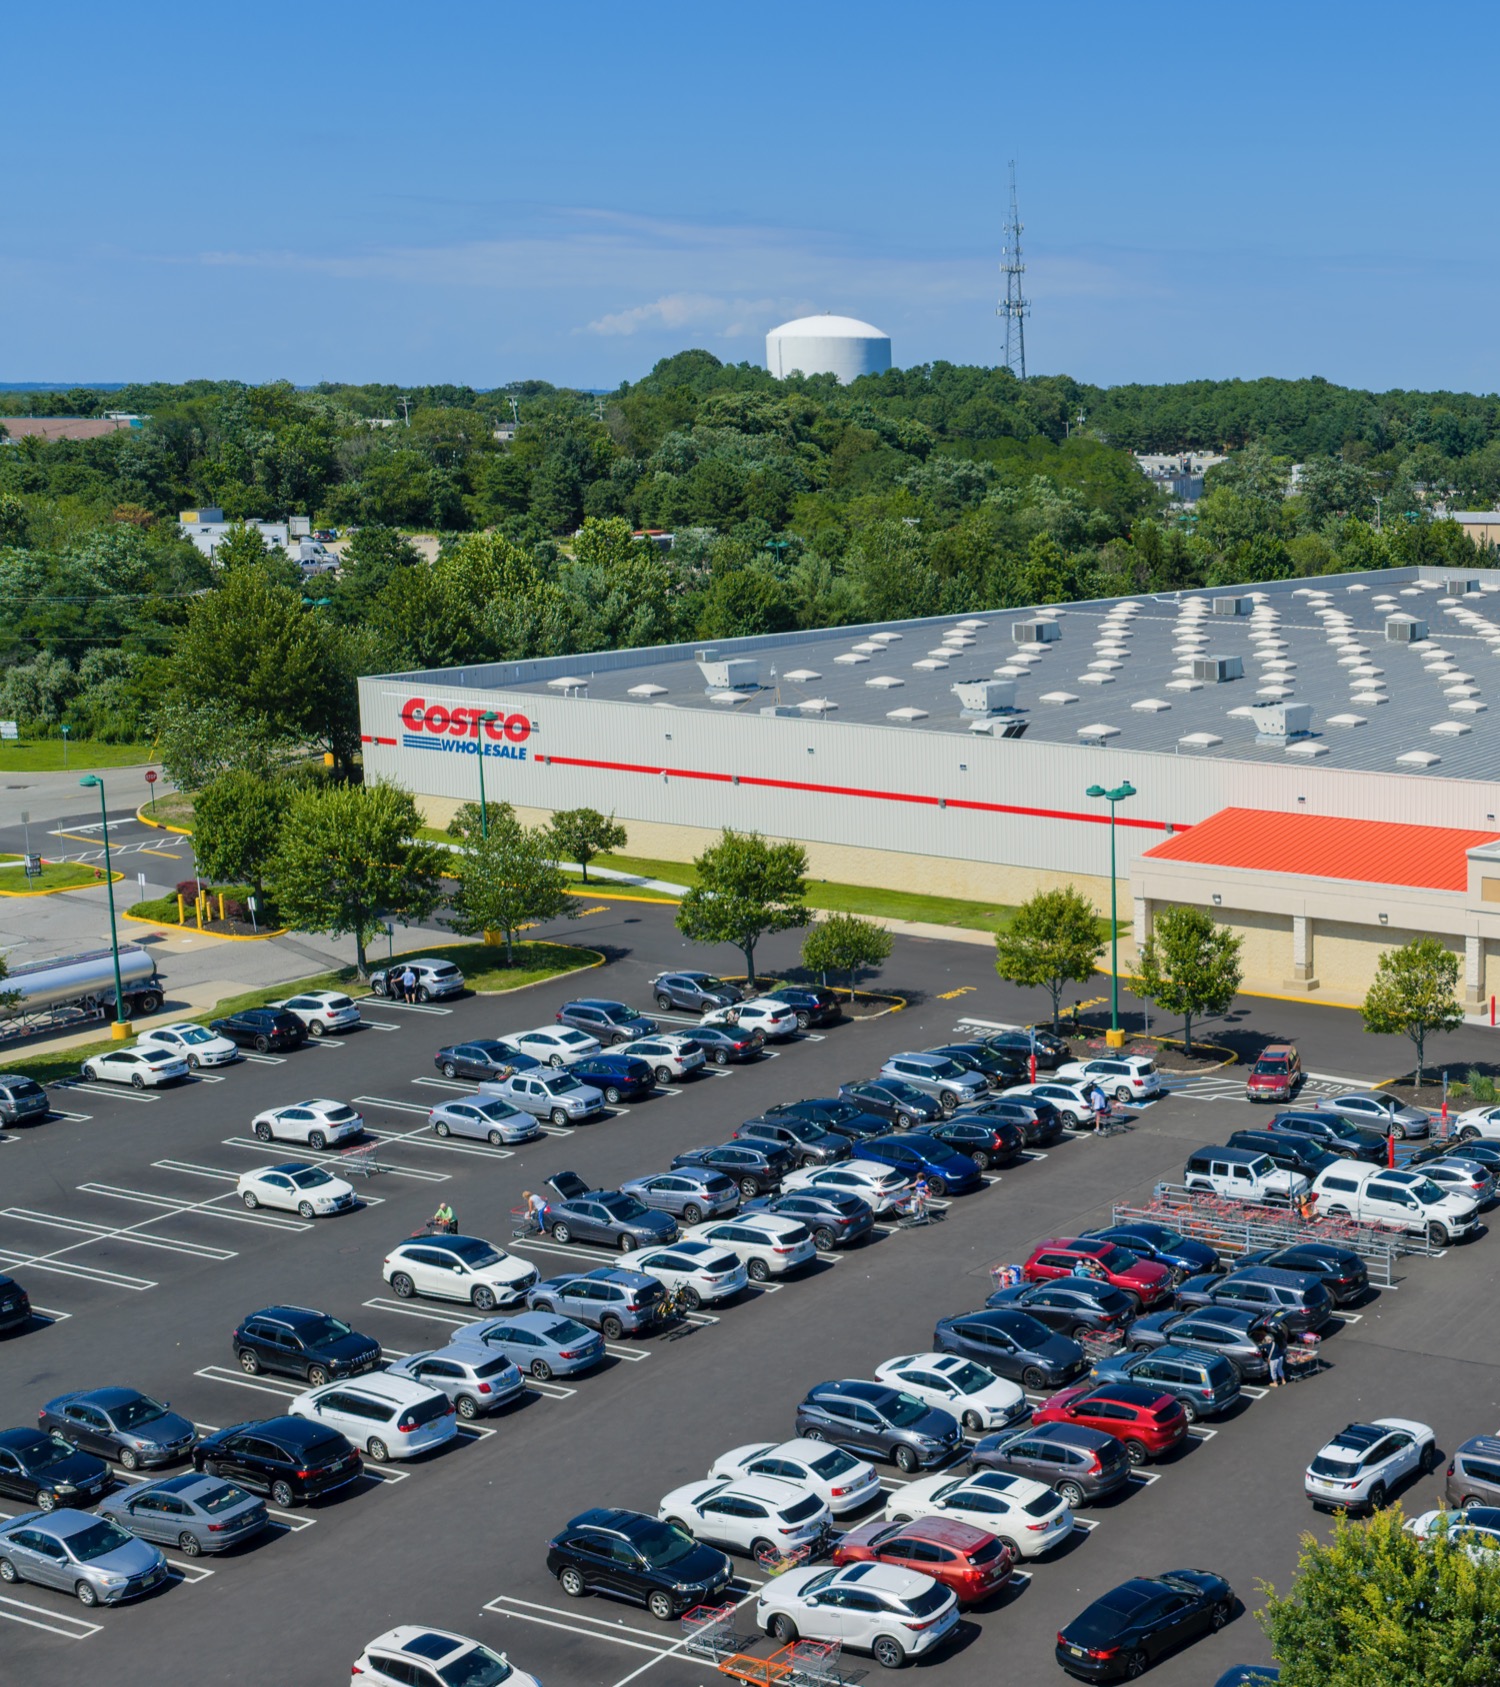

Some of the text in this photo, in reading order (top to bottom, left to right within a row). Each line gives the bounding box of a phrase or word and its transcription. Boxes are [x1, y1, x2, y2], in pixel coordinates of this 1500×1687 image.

[401, 697, 531, 743] COSTCO
[441, 739, 526, 760] WHOLESALE
[952, 1024, 1003, 1037] STOP
[1303, 1081, 1355, 1093] STOP
